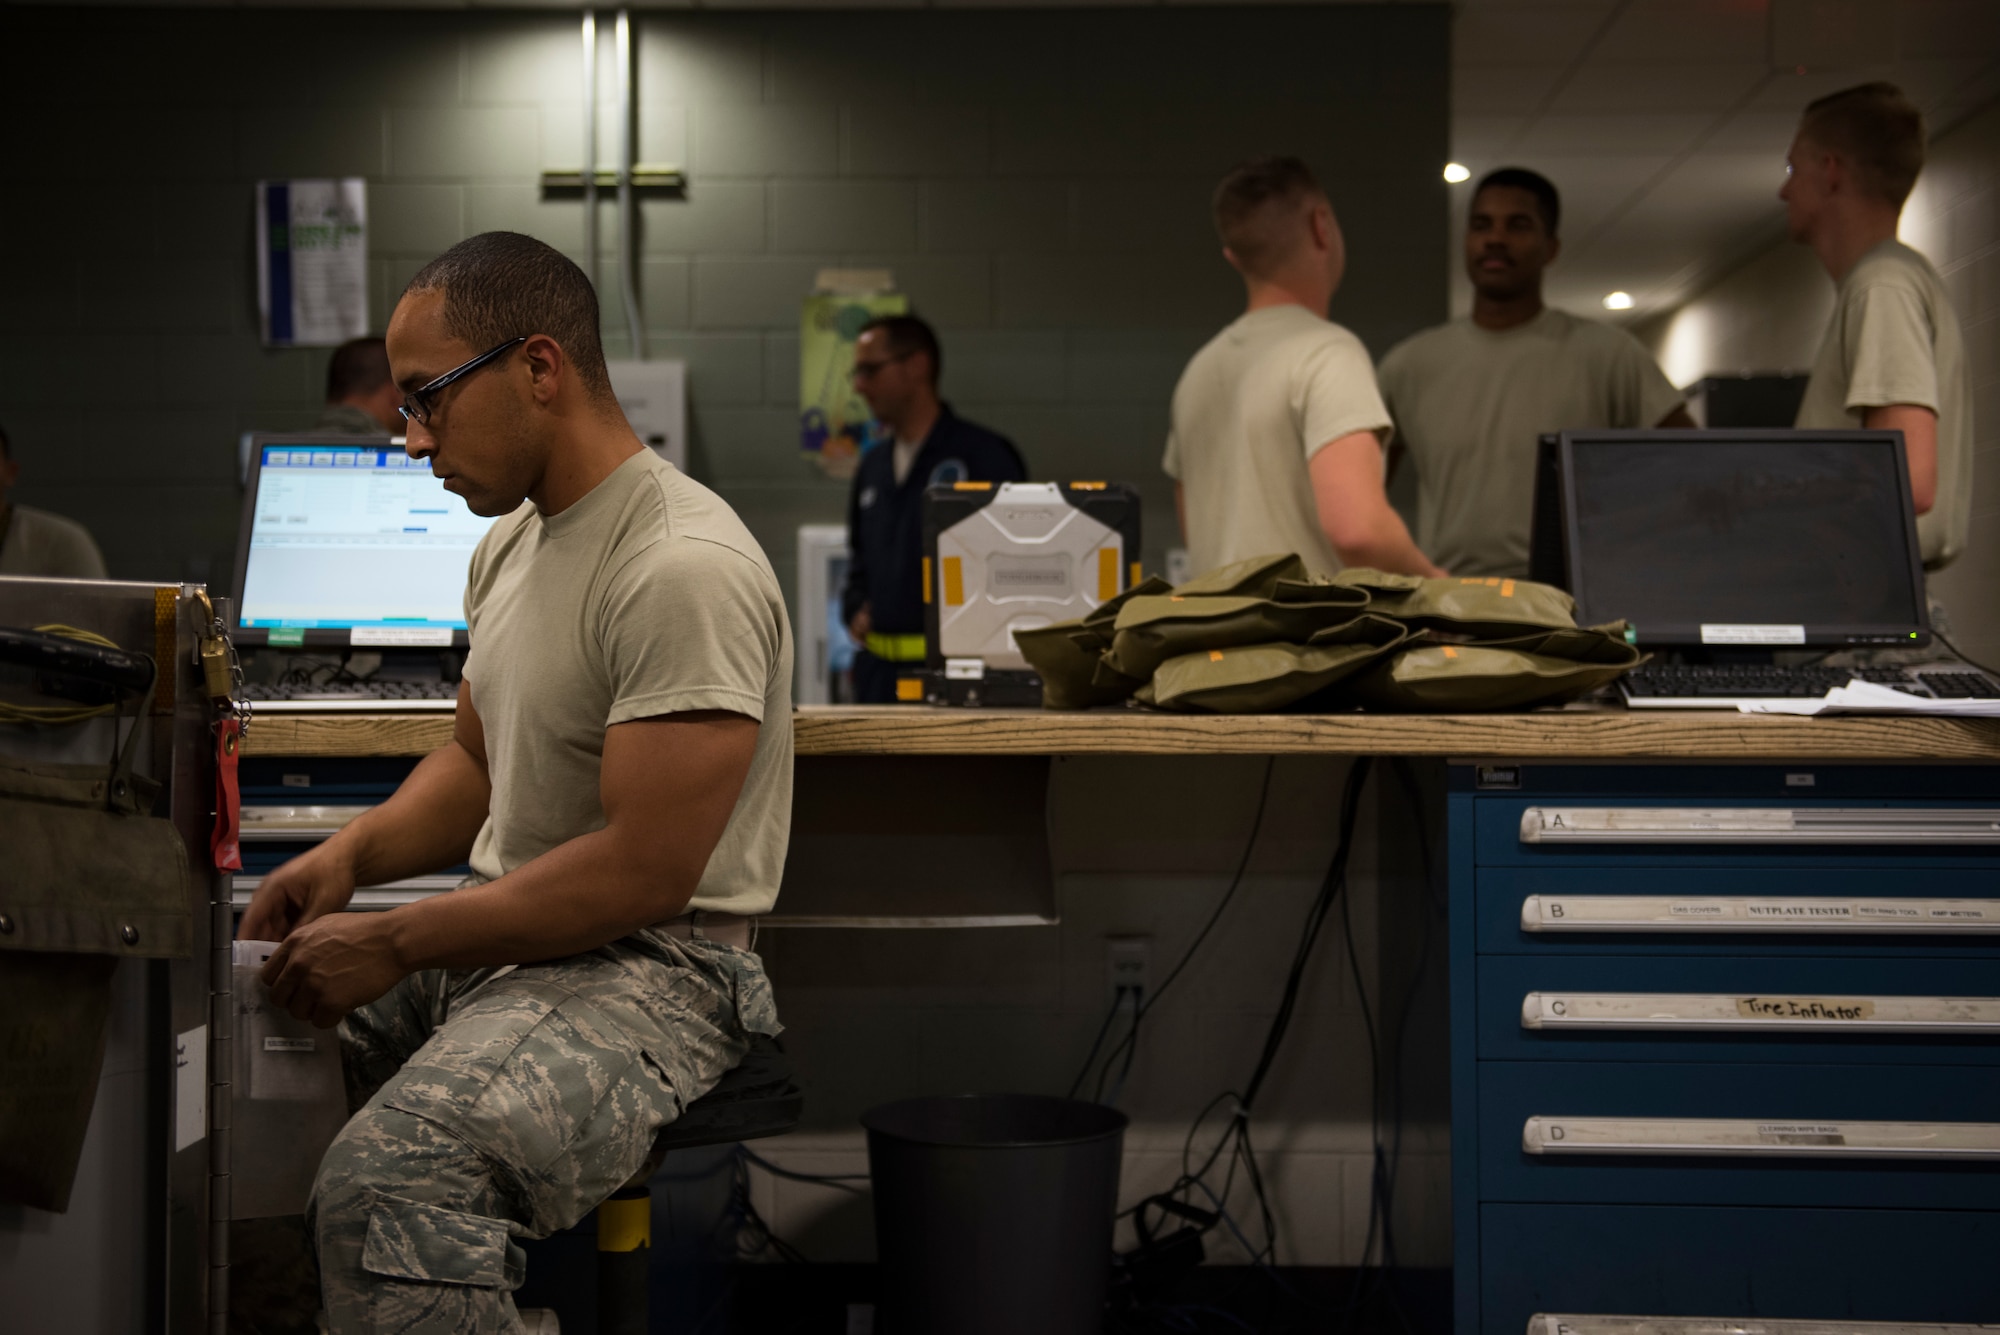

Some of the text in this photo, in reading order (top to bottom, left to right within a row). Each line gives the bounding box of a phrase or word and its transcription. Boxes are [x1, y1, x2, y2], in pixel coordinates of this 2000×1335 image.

[1553, 813, 1565, 828] A
[1551, 904, 1564, 918] B
[1750, 906, 1850, 916] NUTPLATE TESTER
[1552, 1001, 1566, 1015] C
[1743, 997, 1862, 1019] Tire Inflator
[1550, 1126, 1565, 1140] D
